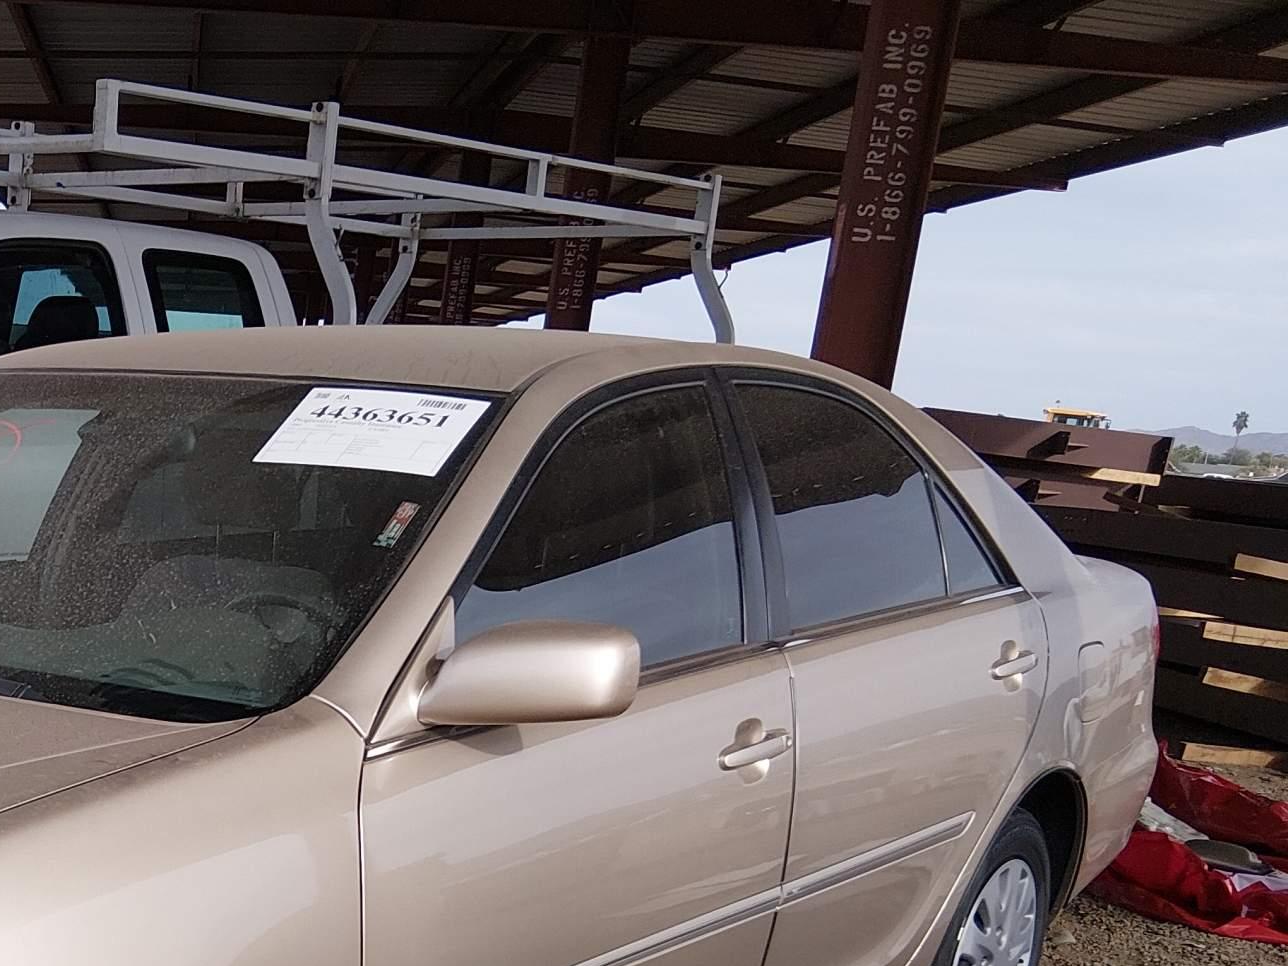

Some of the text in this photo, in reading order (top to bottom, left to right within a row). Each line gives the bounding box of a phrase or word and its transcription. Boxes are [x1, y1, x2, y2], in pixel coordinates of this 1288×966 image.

[851, 22, 910, 243] U.S. PREFAB INC.
[876, 24, 934, 243] 1-866-799-0969
[310, 403, 450, 428] 44363651
